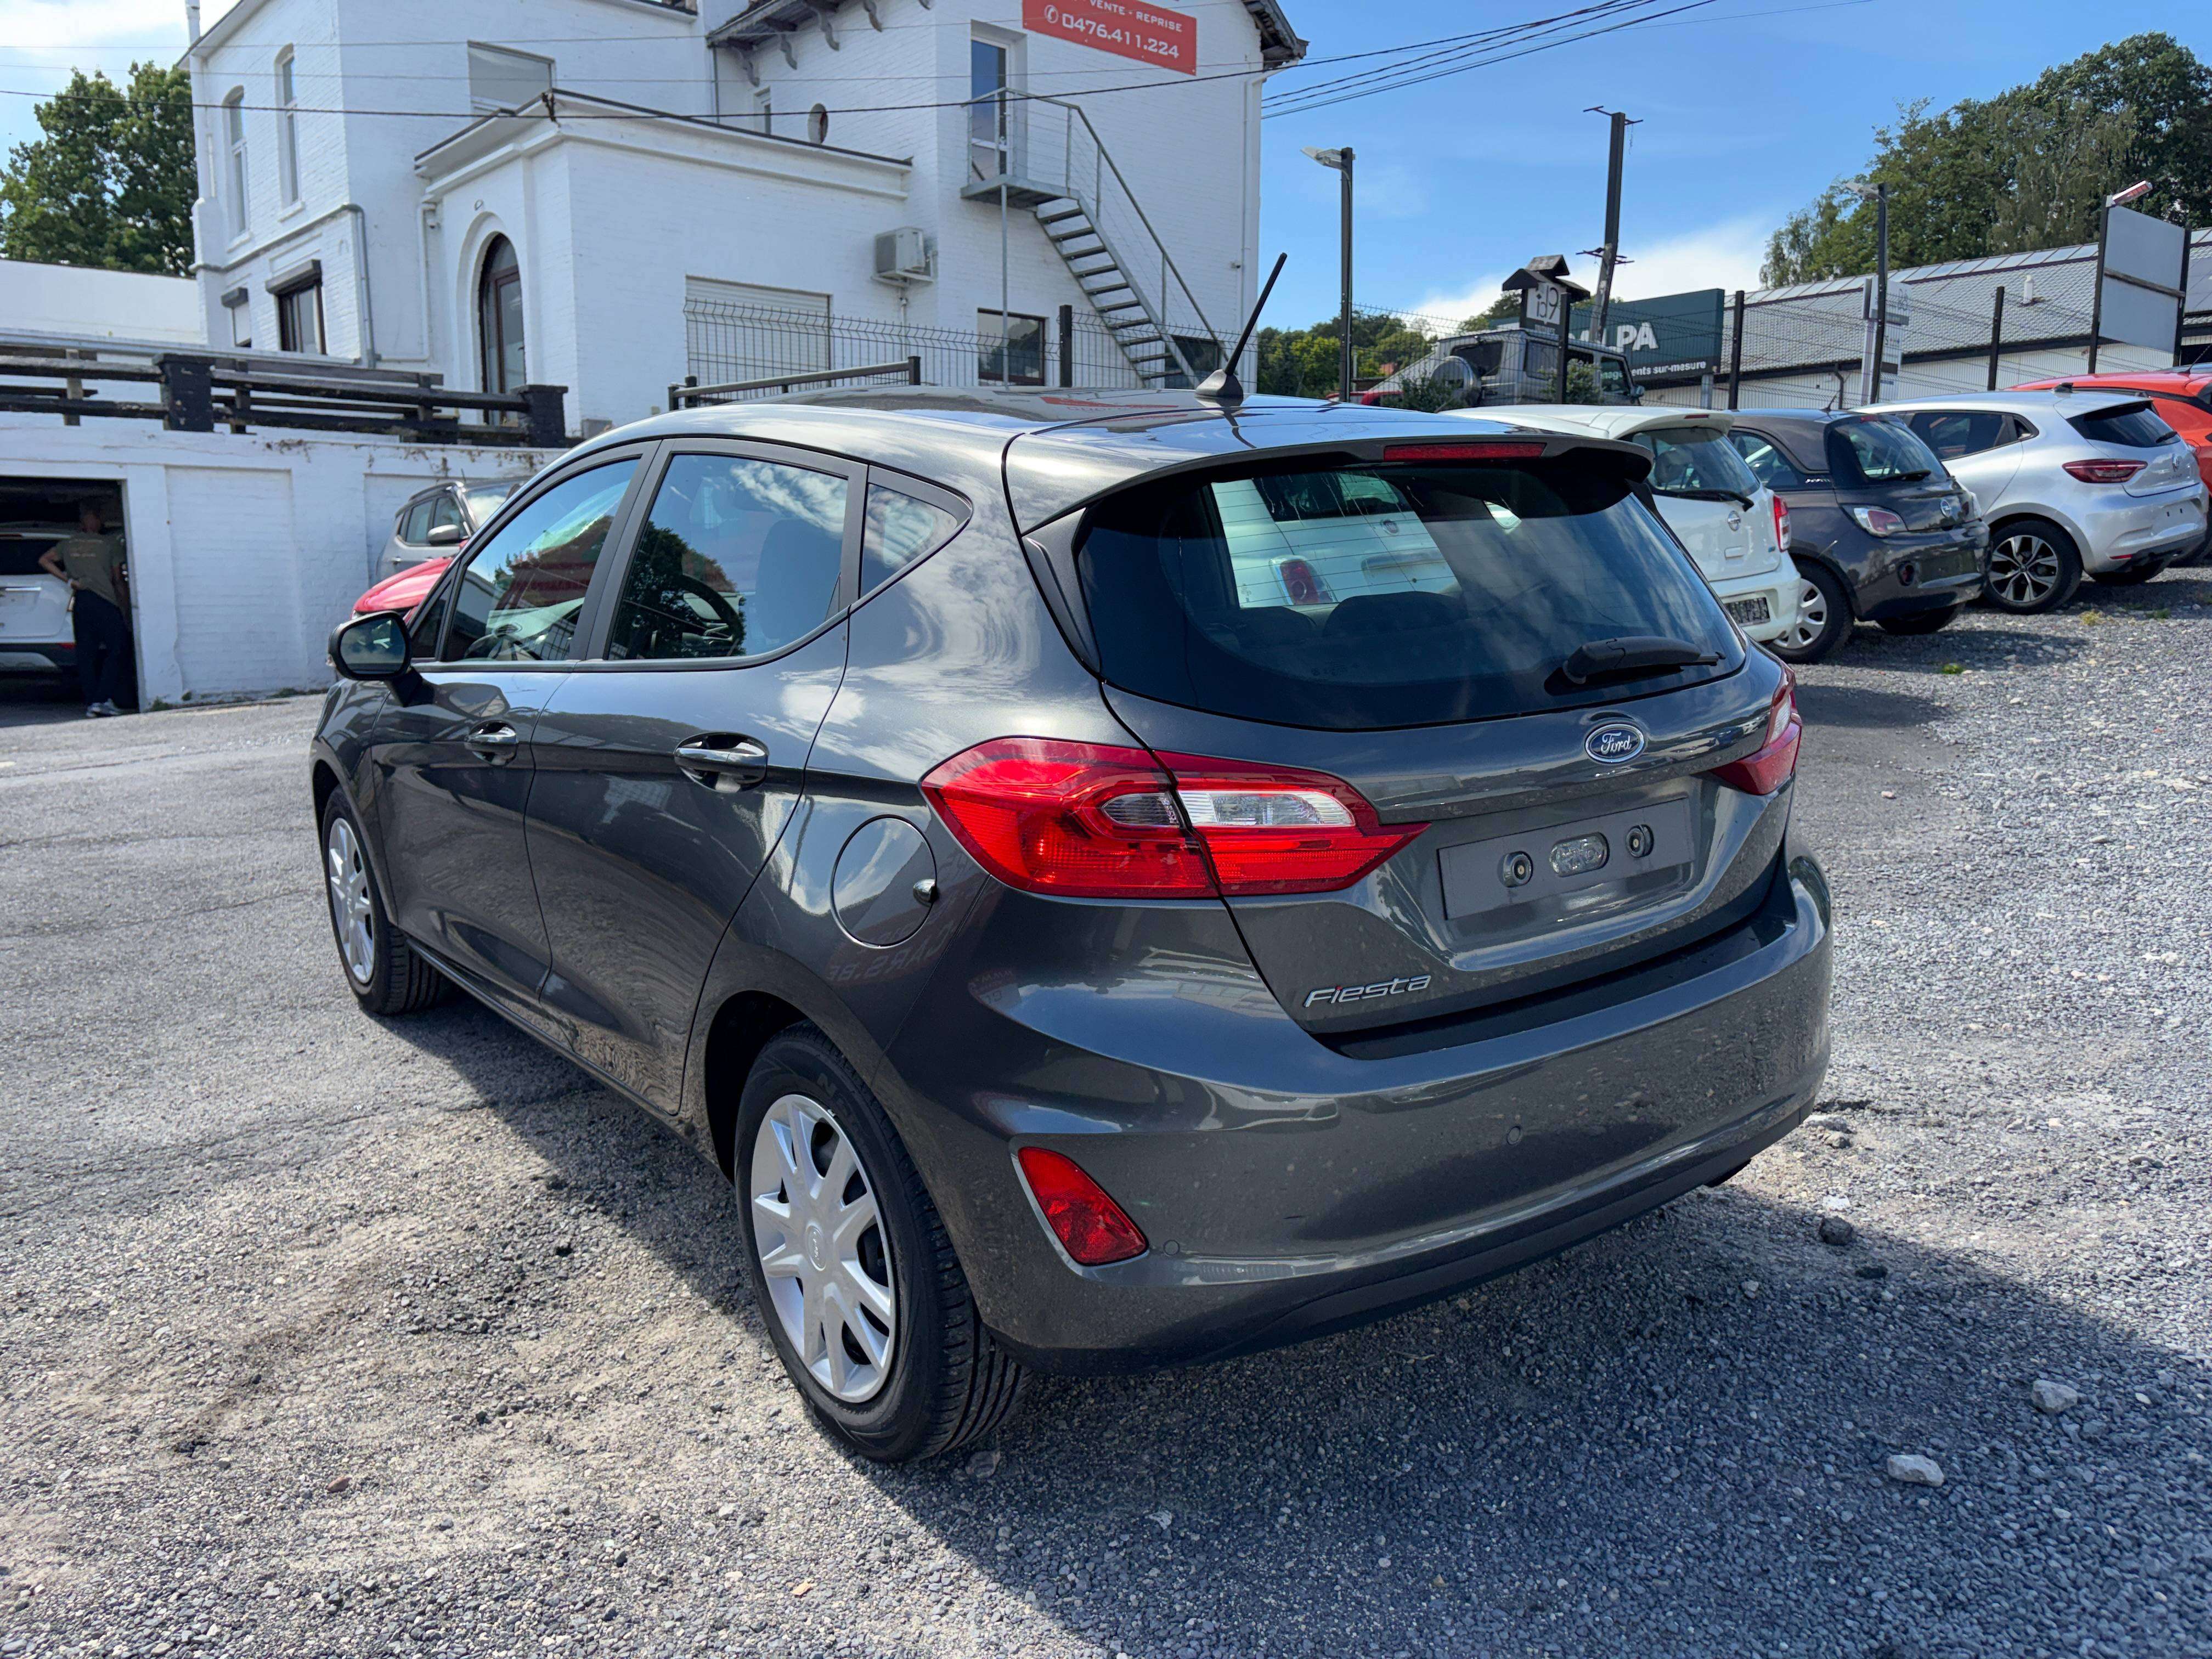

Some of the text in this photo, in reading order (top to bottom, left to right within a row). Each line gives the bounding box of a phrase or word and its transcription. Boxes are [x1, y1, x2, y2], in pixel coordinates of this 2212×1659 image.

[1090, 0, 1125, 15] VENTE
[1136, 11, 1182, 32] REPRISE
[1062, 13, 1179, 59] 0476.411.224
[1652, 360, 1707, 375] sur-mesure
[1600, 731, 1632, 755] Ford
[1304, 974, 1431, 1008] Fiesta
